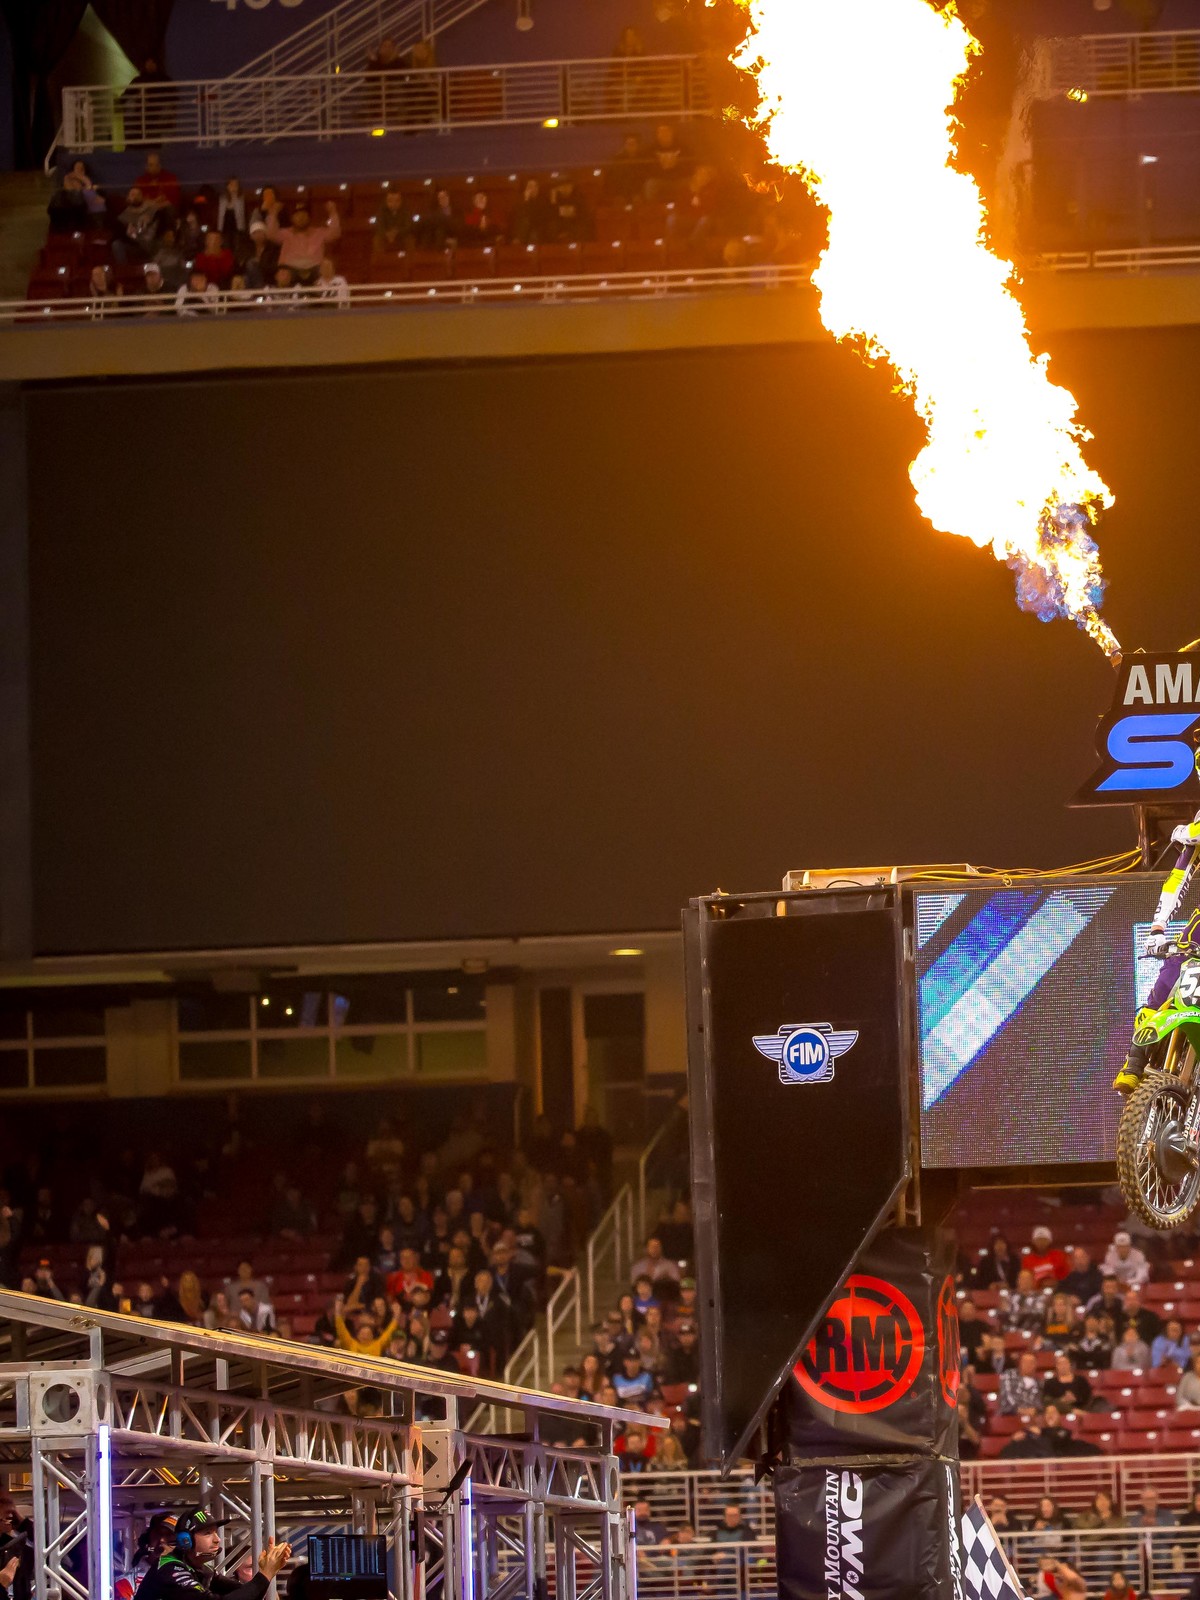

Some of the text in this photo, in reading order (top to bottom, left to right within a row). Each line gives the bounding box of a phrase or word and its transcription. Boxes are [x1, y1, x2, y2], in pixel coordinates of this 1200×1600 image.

[789, 1042, 823, 1065] FIM
[1182, 1094, 1197, 1139] DUNLOP
[814, 1315, 896, 1373] RM
[825, 1469, 840, 1586] MOUNTAIN
